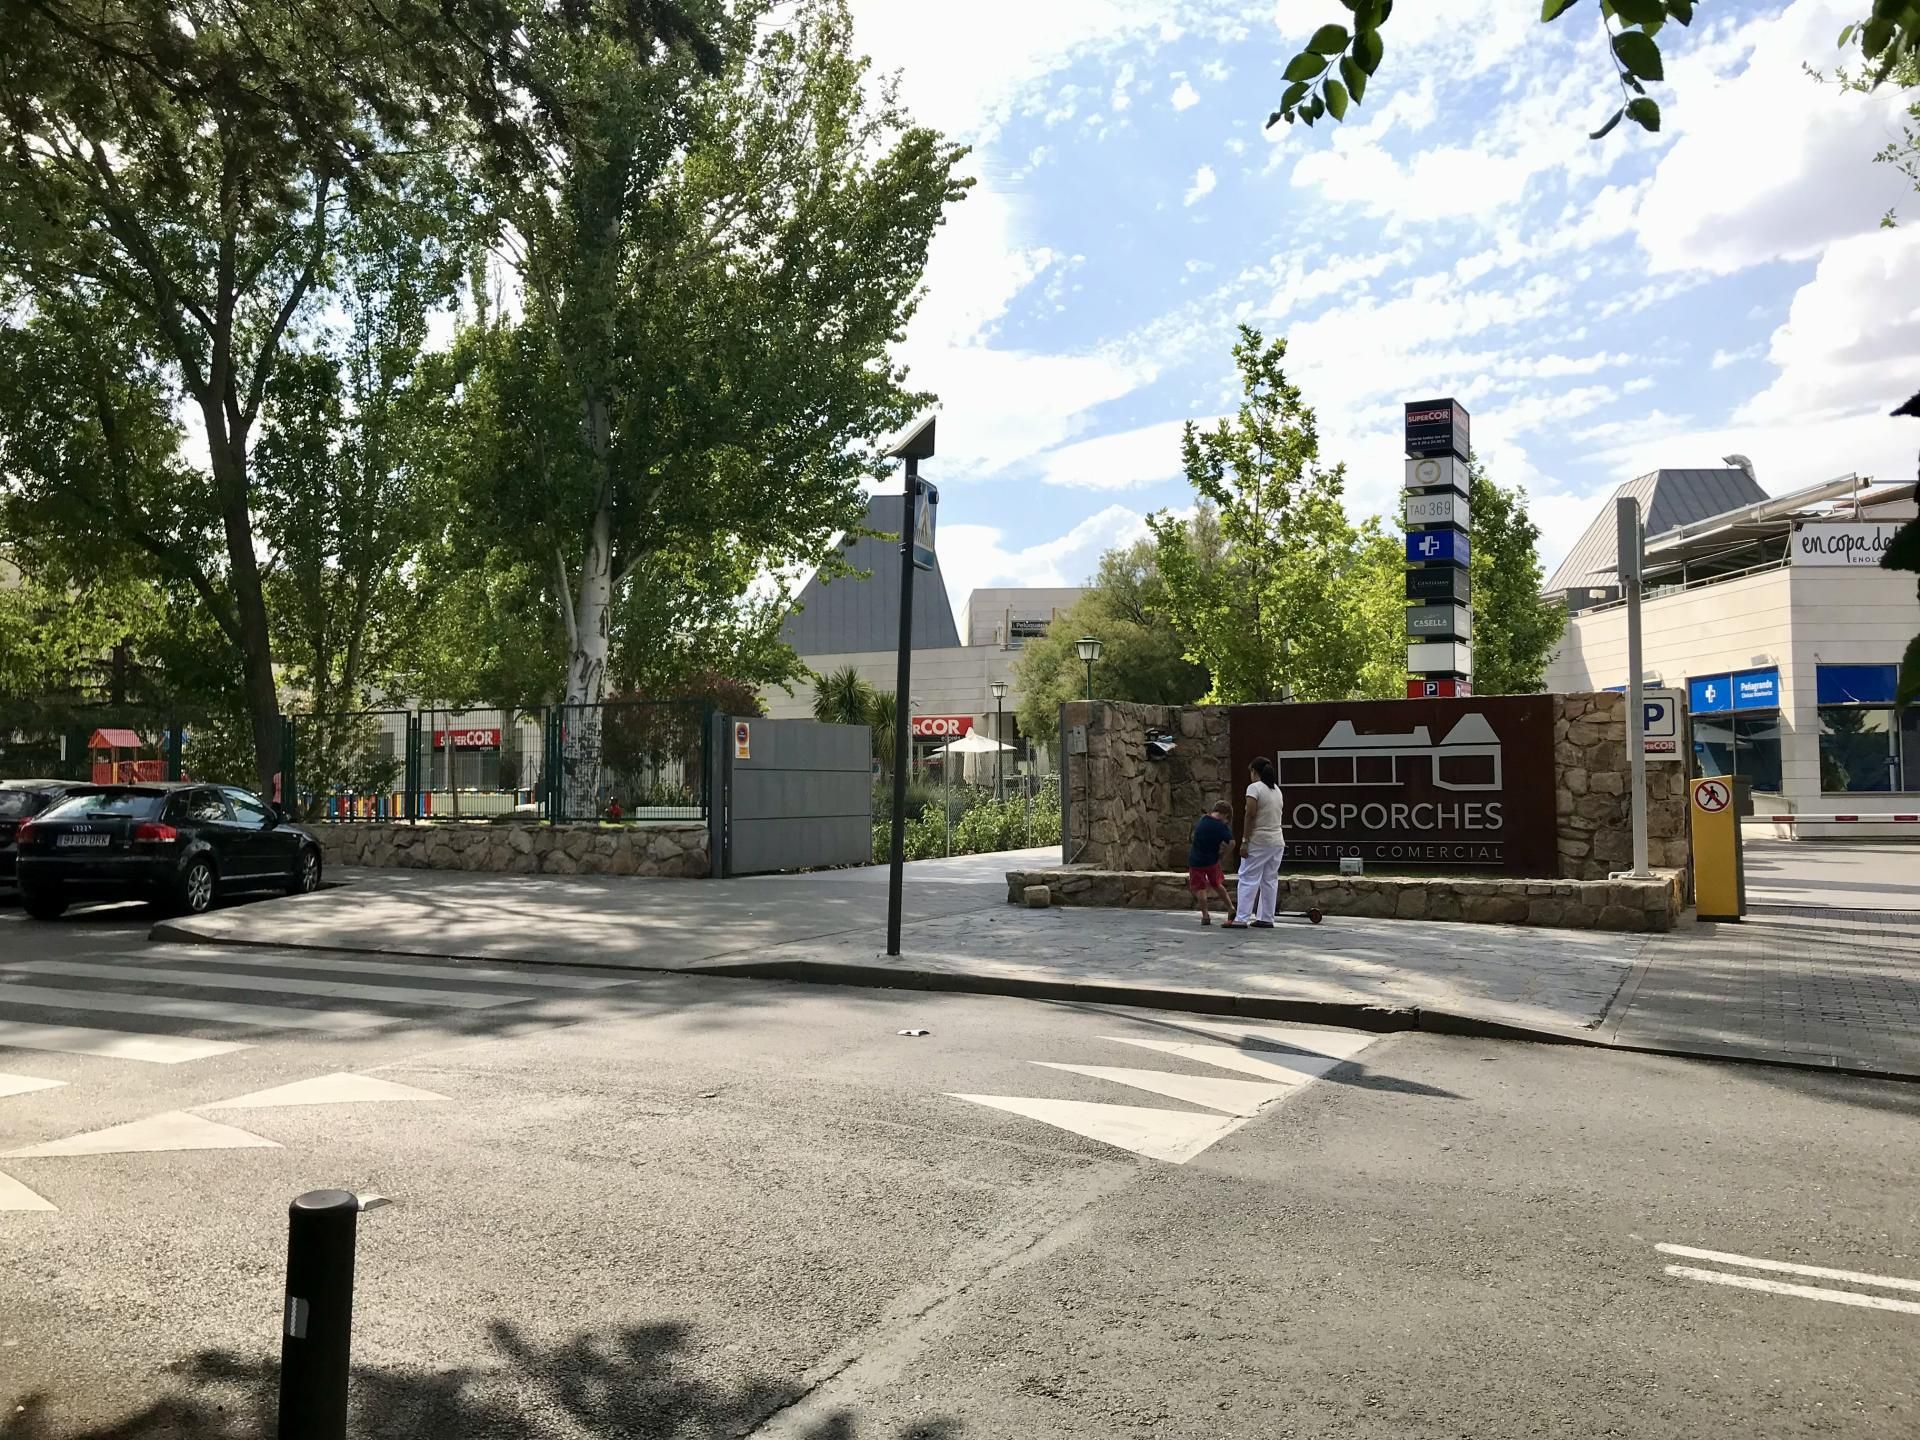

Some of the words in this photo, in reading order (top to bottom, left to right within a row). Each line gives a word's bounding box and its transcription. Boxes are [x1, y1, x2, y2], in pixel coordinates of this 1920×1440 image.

[1408, 411, 1449, 422] SUPERCOR
[1410, 504, 1426, 516] TAO
[1429, 501, 1451, 516] 369
[1802, 536, 1826, 554] en
[1827, 534, 1871, 563] copa
[1414, 619, 1448, 628] CASELLA
[1426, 684, 1436, 695] P
[1643, 704, 1664, 731] P
[912, 719, 960, 735] RCOR
[1375, 846, 1502, 859] COMERCIAL
